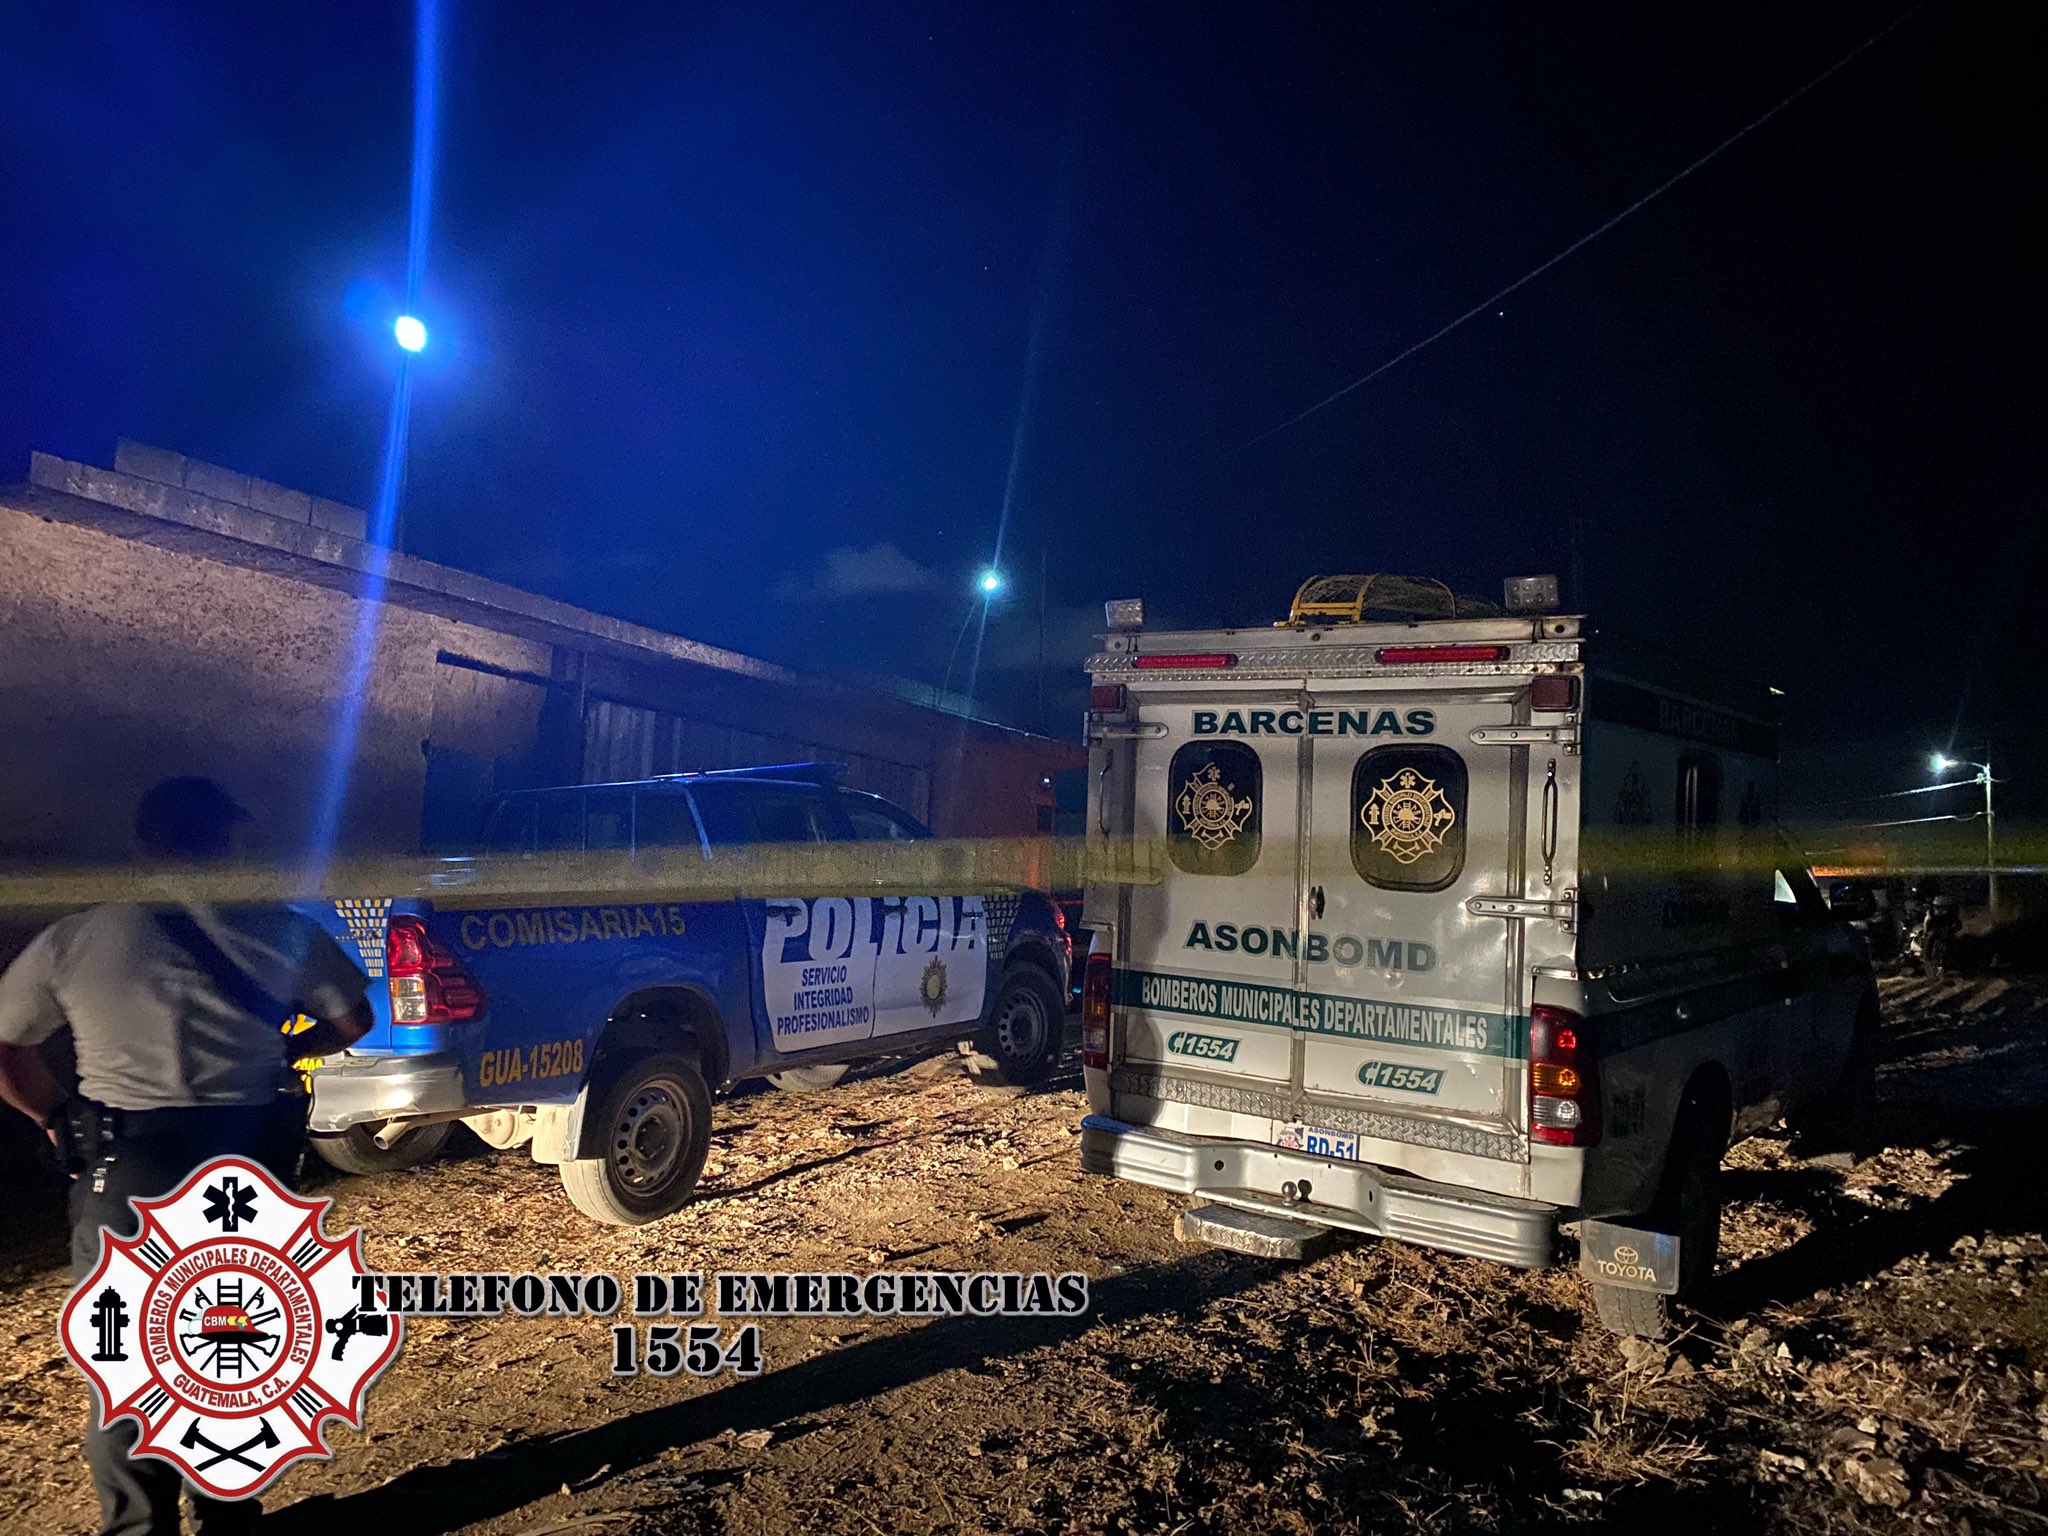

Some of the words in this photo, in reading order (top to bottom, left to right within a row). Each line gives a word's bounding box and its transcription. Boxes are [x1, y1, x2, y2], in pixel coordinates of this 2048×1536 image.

[1194, 710, 1435, 735] BARCENAS
[1187, 922, 1437, 972] ASONBOMD
[802, 965, 847, 986] SERVICIO
[794, 987, 853, 1010] INTEGRIDAD
[778, 1006, 869, 1036] PROFESIONALISMO
[1142, 976, 1216, 1013] BOMBEROS
[1221, 985, 1319, 1030] MUNICIPALES
[1324, 1000, 1487, 1049] DEPARTAMENTALES
[1186, 1035, 1233, 1060] 1554
[480, 1039, 583, 1087] GUA-15208
[1379, 1066, 1437, 1090] 1554
[1308, 1126, 1354, 1139] ASONBOMD
[1307, 1136, 1353, 1160] RD-51
[1598, 1260, 1656, 1281] TOYOTA
